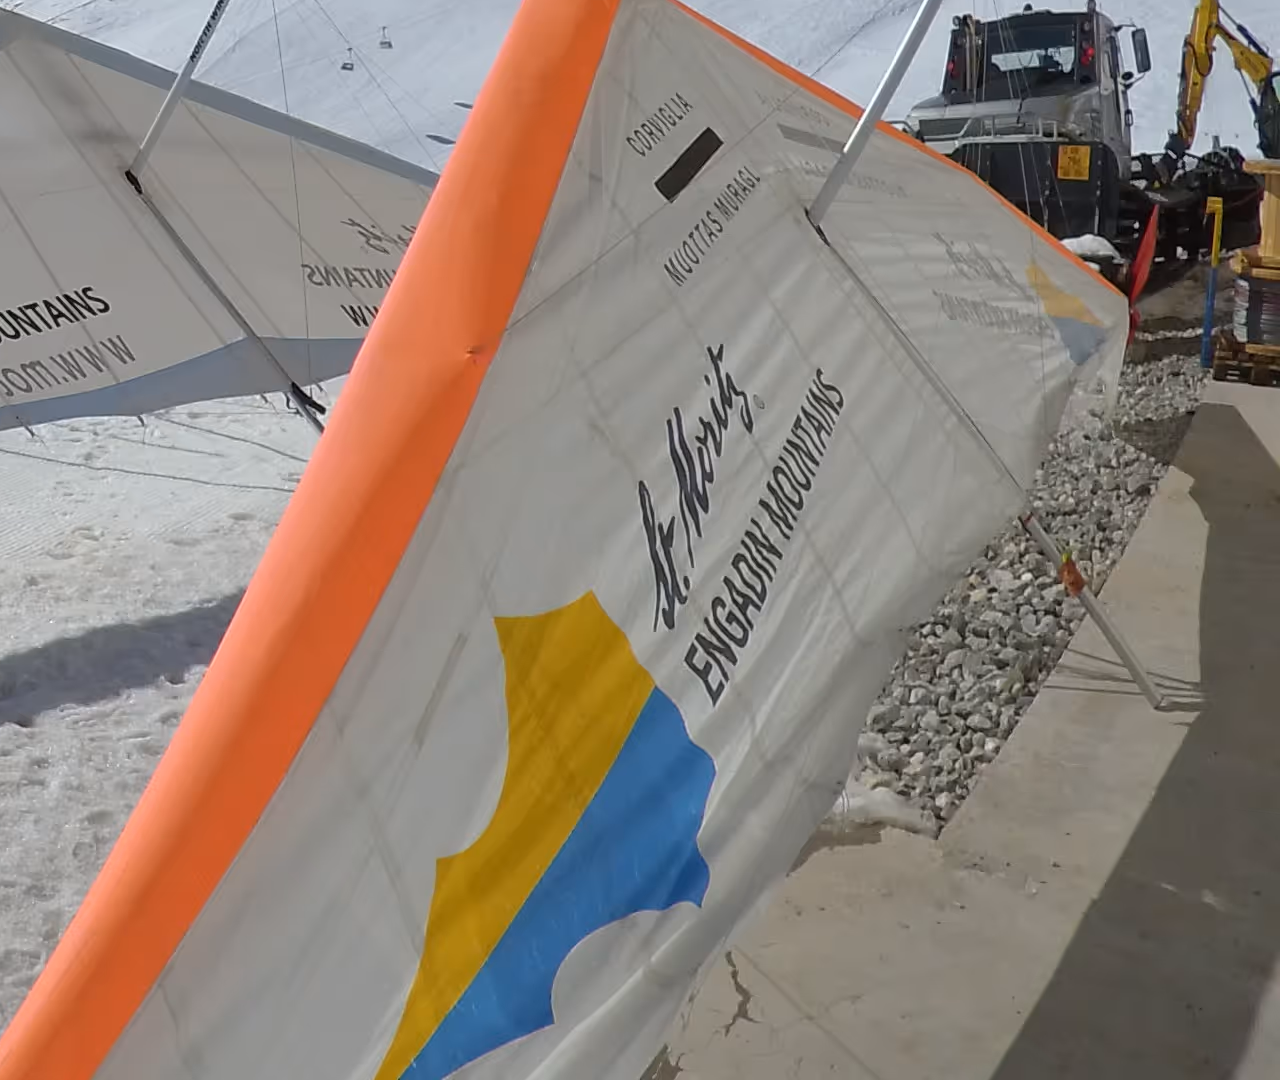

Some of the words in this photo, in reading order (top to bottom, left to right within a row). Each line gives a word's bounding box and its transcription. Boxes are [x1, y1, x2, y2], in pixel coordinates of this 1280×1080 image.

[626, 92, 693, 157] CORVIGLIA
[663, 210, 724, 287] MUOTTAS
[713, 166, 761, 222] MURAGL
[662, 343, 754, 569] Moritz
[639, 480, 690, 632] St.
[684, 517, 783, 708] ENGADIN
[758, 368, 844, 541] MOUNTAINS
